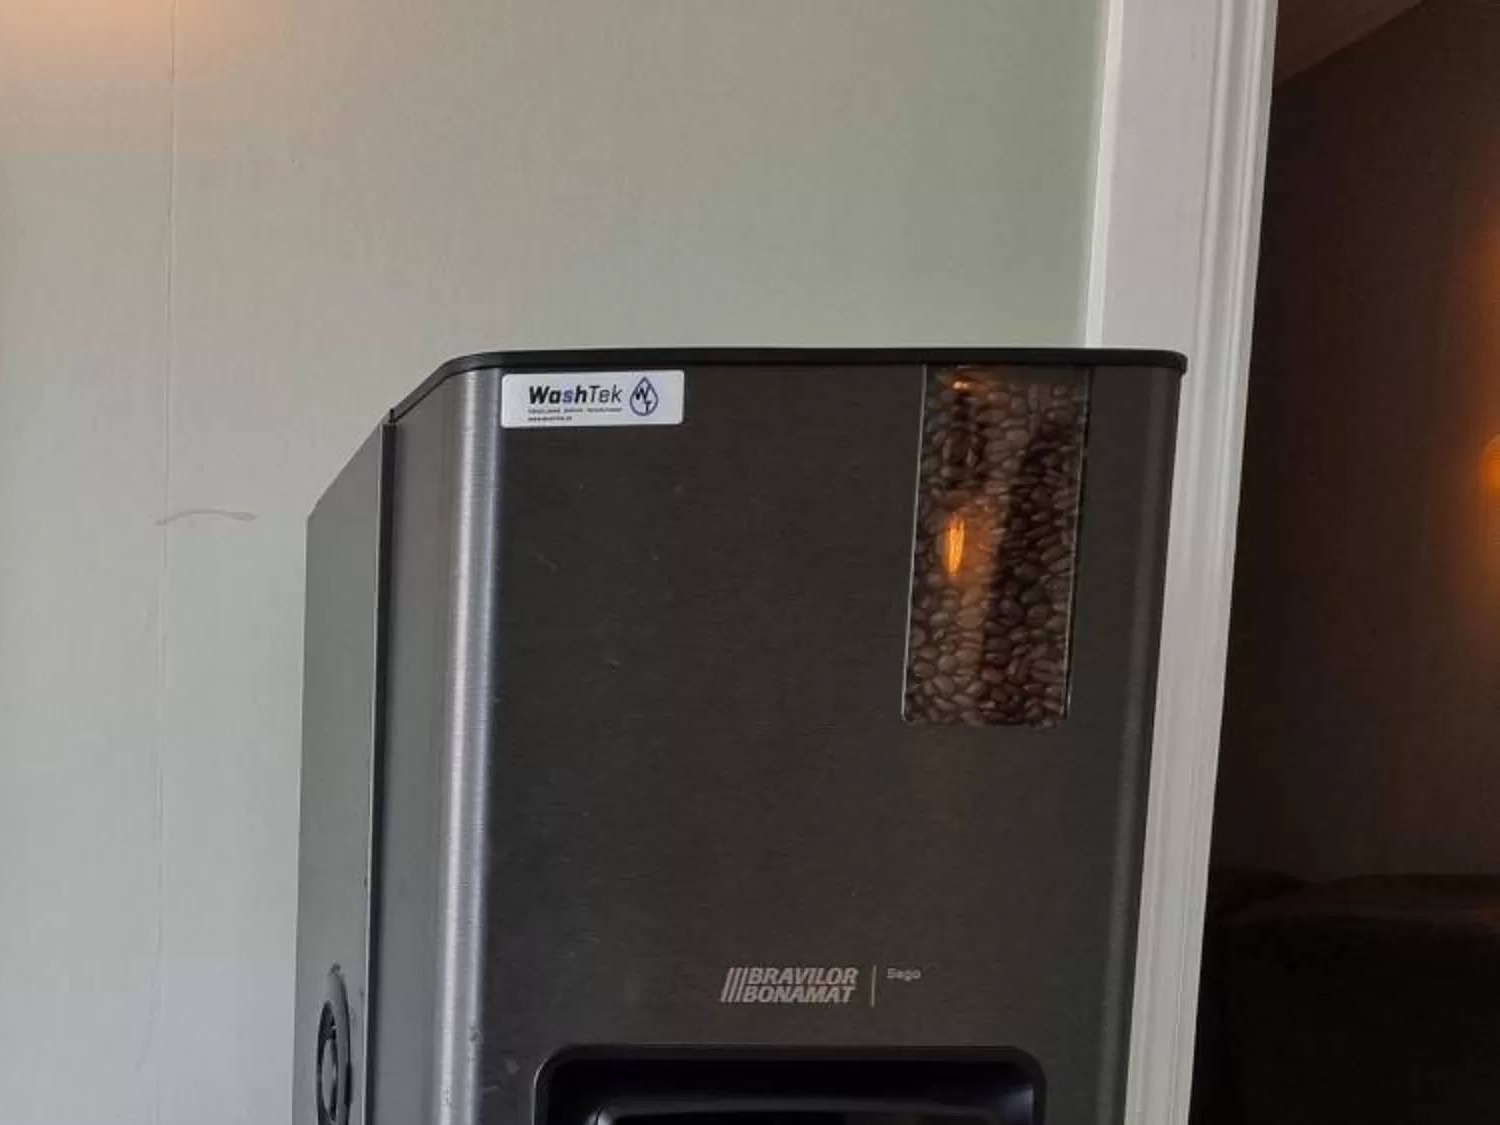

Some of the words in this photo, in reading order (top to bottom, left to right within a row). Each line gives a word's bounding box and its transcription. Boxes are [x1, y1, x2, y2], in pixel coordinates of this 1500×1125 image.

[528, 384, 623, 405] WashTek
[748, 966, 860, 985] BRAVILOR
[742, 985, 856, 1004] BONAMAT
